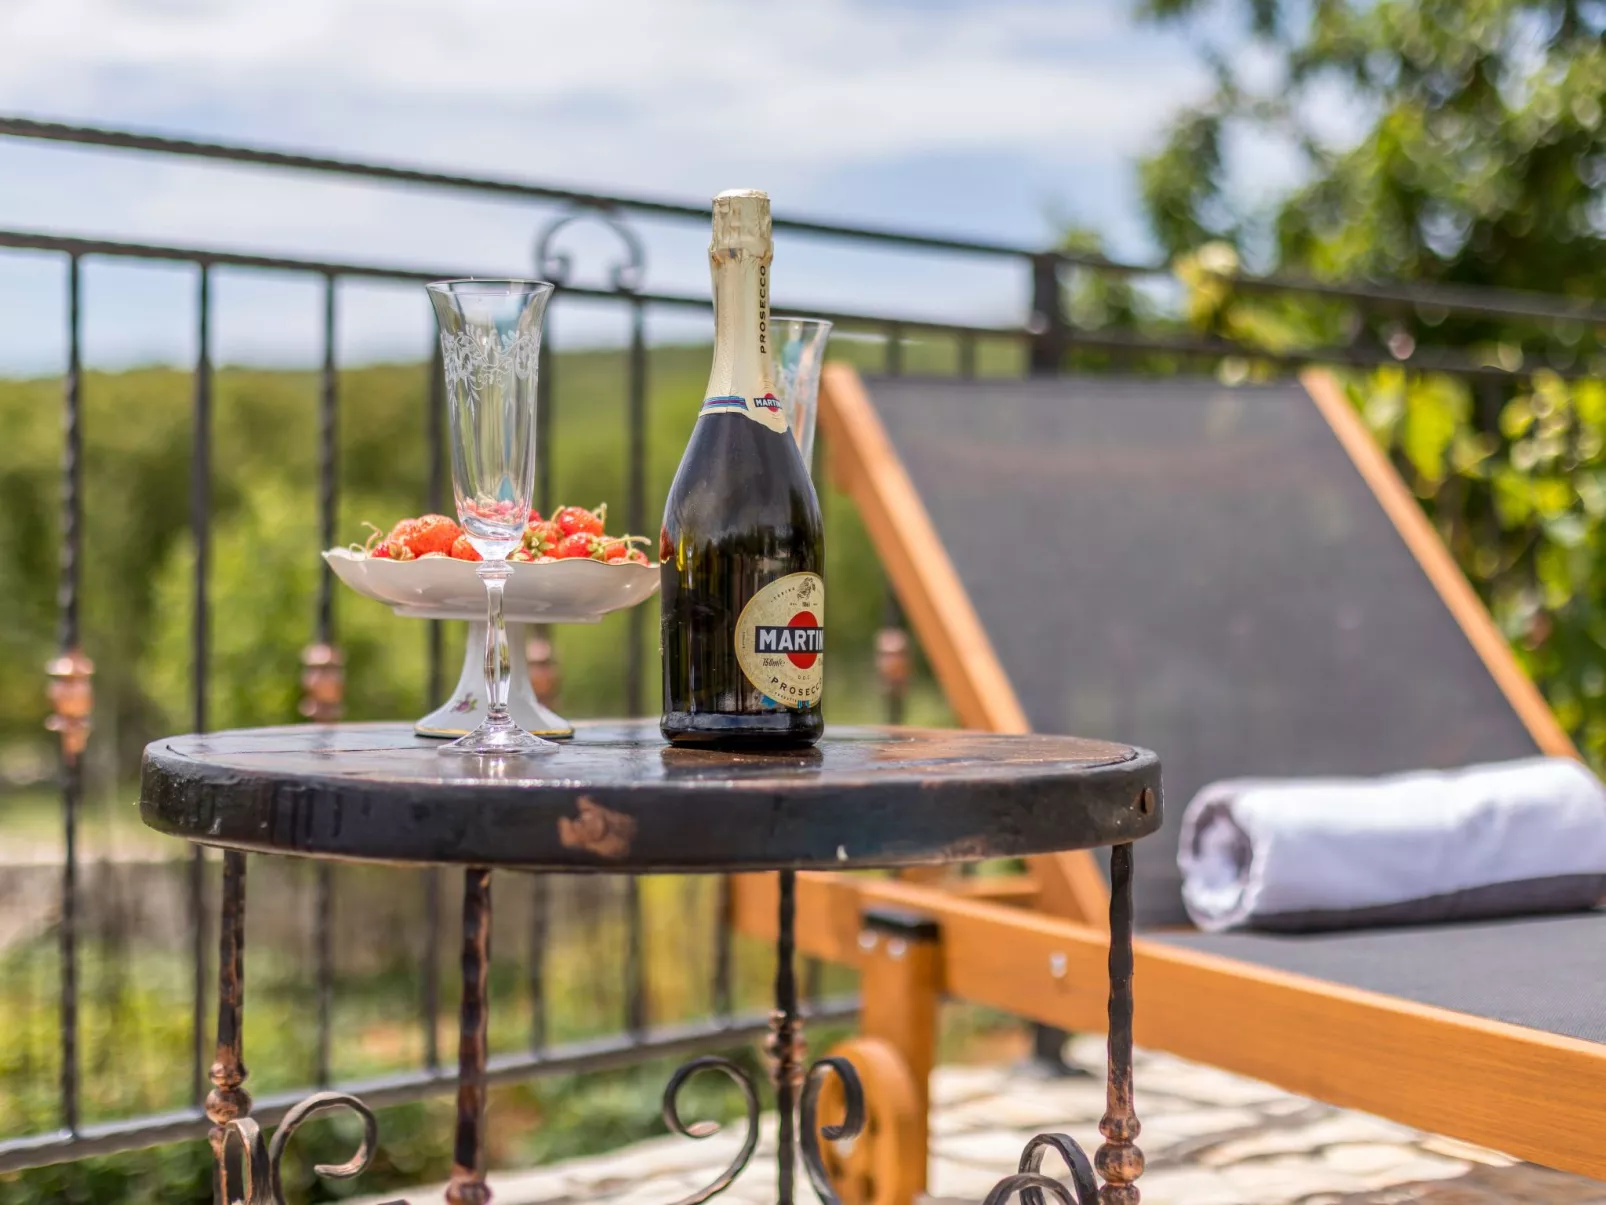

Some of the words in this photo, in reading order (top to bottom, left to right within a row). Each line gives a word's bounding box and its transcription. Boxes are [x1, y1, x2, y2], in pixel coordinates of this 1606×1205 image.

[755, 399, 782, 408] MARTIN
[759, 629, 824, 651] MARTIN
[771, 676, 822, 696] PROSECC
